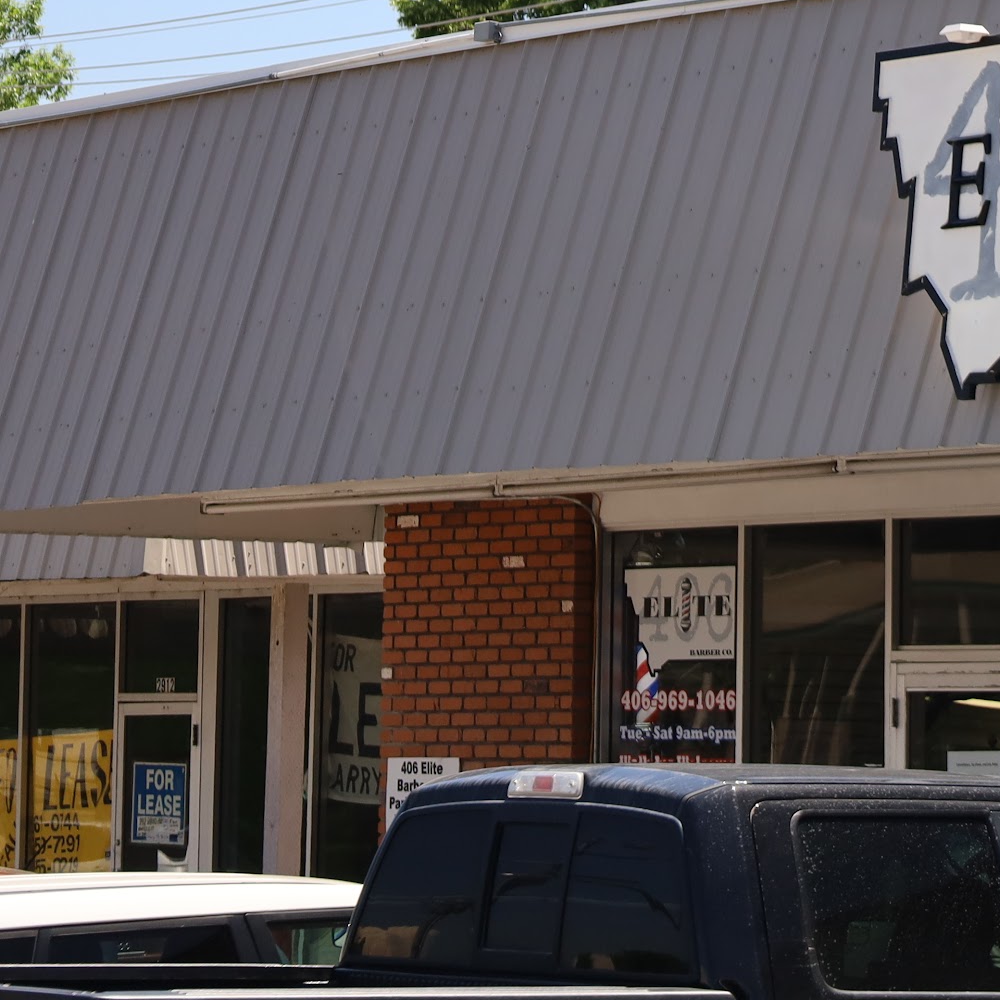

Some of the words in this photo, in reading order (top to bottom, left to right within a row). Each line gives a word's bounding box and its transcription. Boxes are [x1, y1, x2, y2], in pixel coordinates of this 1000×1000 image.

[639, 572, 733, 642] 406
[333, 643, 356, 672] OR
[689, 649, 720, 657] BARBER
[156, 677, 175, 692] 2912
[621, 689, 736, 711] 406-969-1046
[620, 725, 642, 739] Tue
[653, 724, 673, 739] Sat
[676, 724, 736, 745] 9am-6pm
[401, 761, 418, 775] 406
[421, 761, 443, 775] Elite
[146, 769, 174, 790] FOR
[329, 763, 382, 796] ARRY
[138, 794, 181, 816] LEASE
[389, 797, 404, 809] Pa
